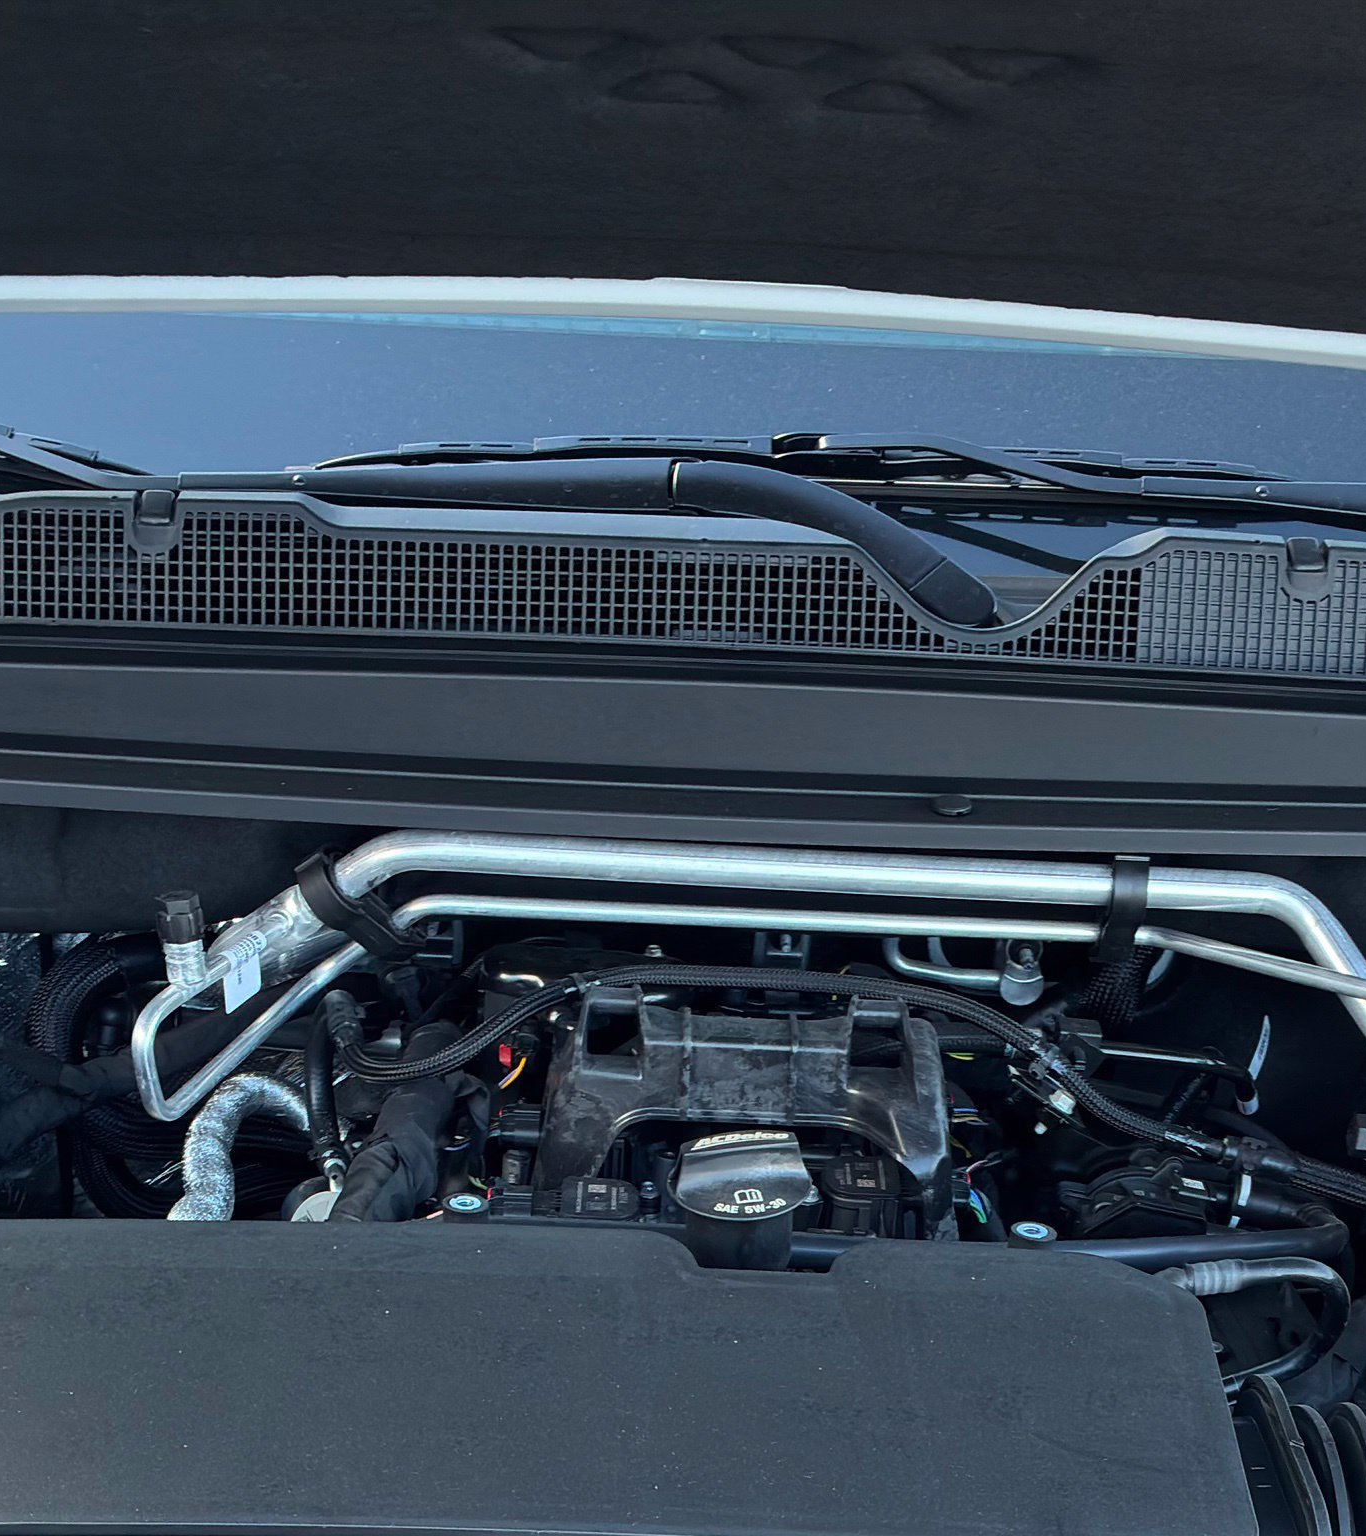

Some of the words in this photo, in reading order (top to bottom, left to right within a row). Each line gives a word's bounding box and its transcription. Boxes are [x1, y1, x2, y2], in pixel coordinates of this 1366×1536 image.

[694, 1131, 789, 1149] ACDelco
[714, 1203, 739, 1214] SAE
[744, 1198, 787, 1214] 5W-30
